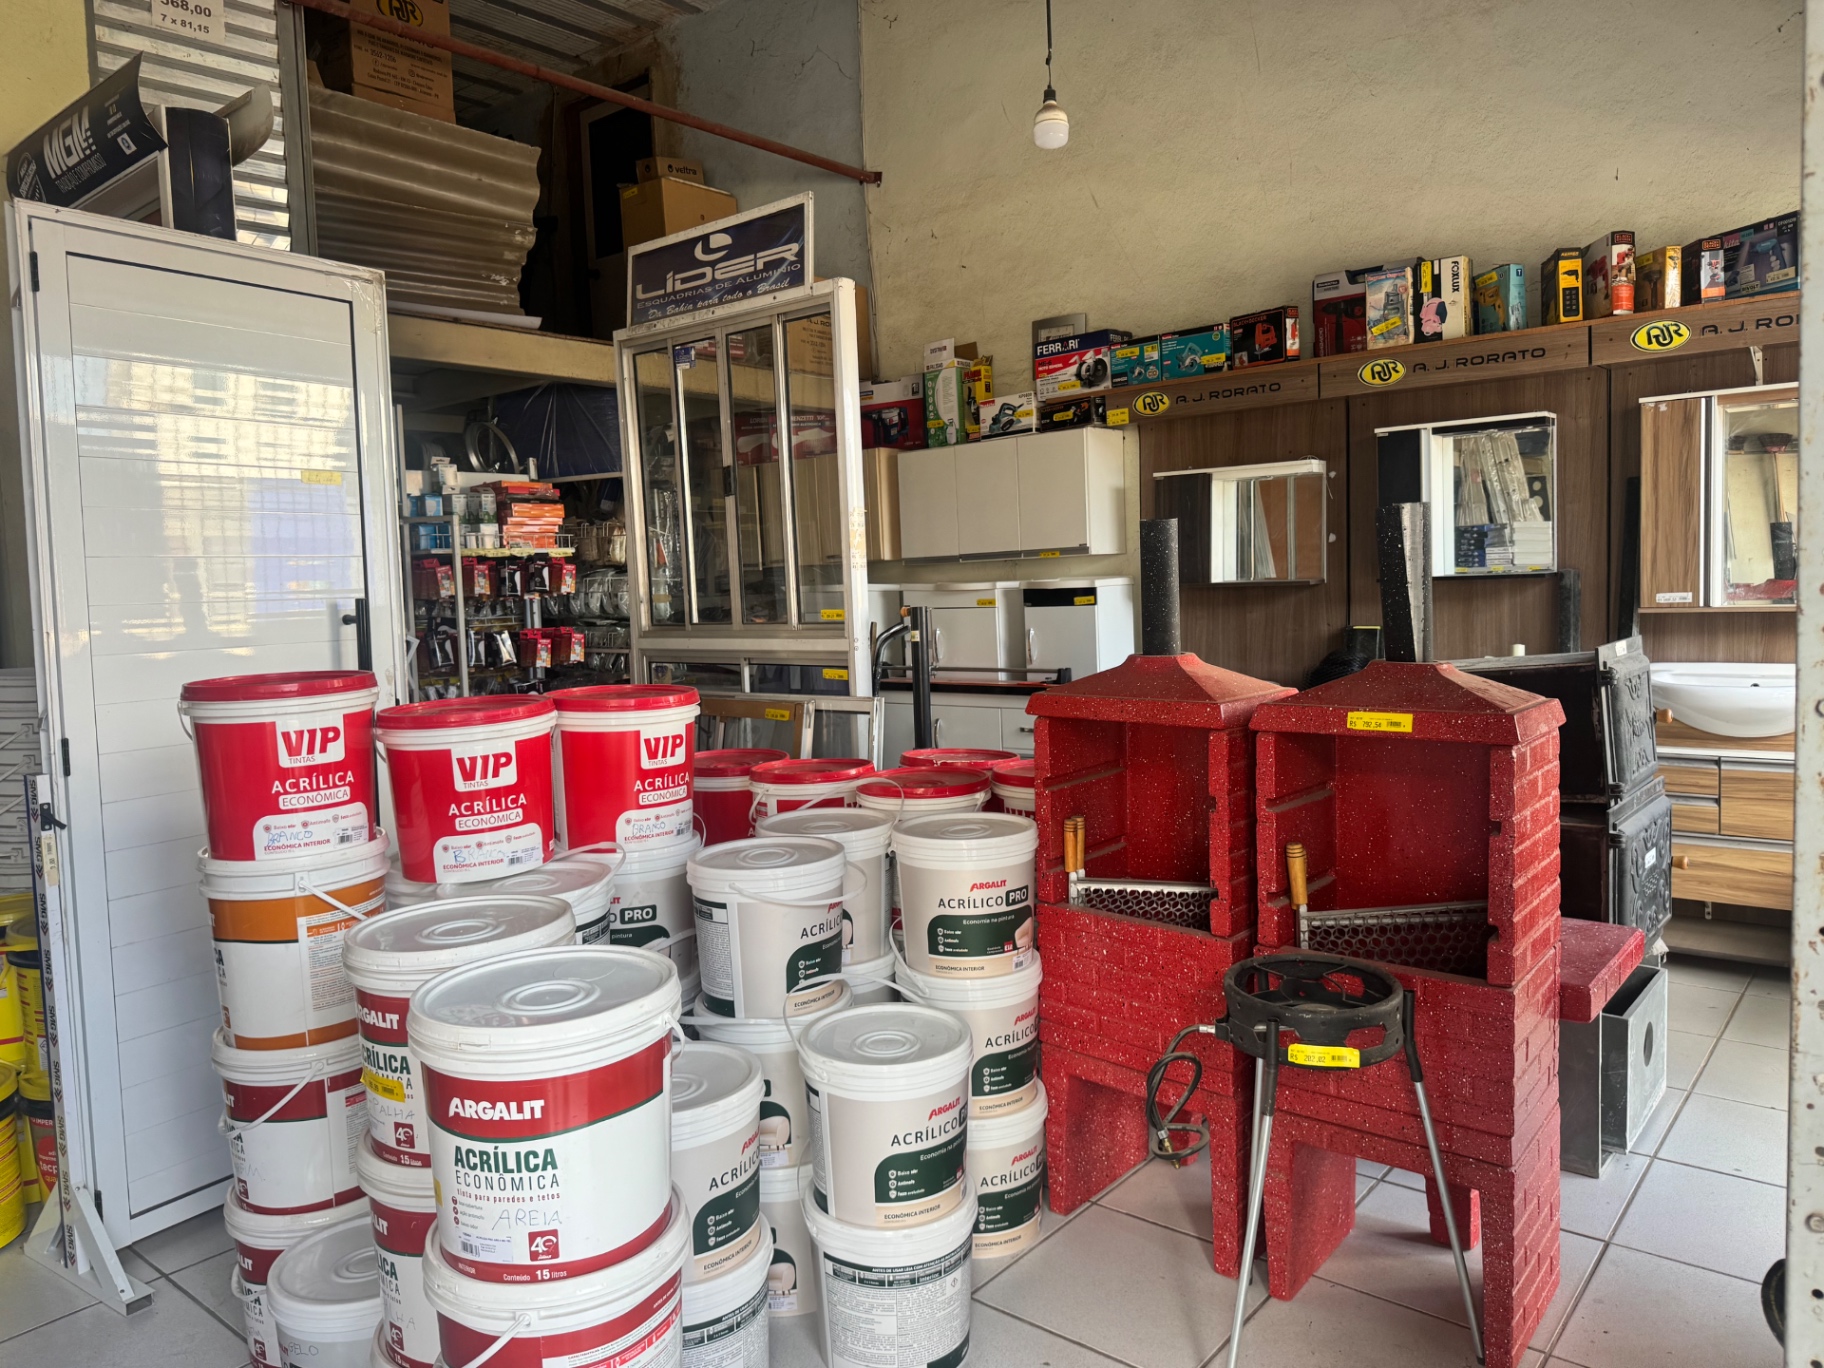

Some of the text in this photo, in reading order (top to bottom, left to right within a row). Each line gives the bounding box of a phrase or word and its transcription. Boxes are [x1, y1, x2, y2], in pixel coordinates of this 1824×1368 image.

[160, 13, 167, 21] 7
[180, 19, 210, 34] 81,15
[1451, 260, 1459, 293] FOXLUX
[636, 285, 712, 309] ESQUADRIAS
[715, 281, 733, 291] DE
[1036, 339, 1080, 356] FERRARI
[1456, 347, 1546, 368] RORATO
[1209, 382, 1281, 400] RORATO
[281, 726, 341, 758] VIP
[643, 733, 684, 760] VIP
[288, 755, 315, 764] TINTAS
[456, 752, 513, 782] VIP
[271, 770, 355, 794] ACRÍLICA
[463, 780, 489, 789] TINTAS
[633, 771, 690, 792] ACRÍLICA
[29, 779, 37, 806] SMG
[282, 788, 349, 807] ECONÔMICA
[641, 788, 687, 803] ECONÔMICA
[448, 793, 527, 816] ACRÍLICA
[458, 810, 521, 828] ECONÔMICA
[264, 838, 331, 851] ECONÔMICA INTERIOR
[267, 830, 313, 846] BRANCO
[33, 836, 42, 863] SMG
[443, 862, 477, 870] ECONÔMICA
[478, 858, 504, 867] INTERIOR
[969, 879, 1007, 893] ARGALIT
[38, 893, 47, 919] SMG
[938, 888, 1027, 909] ACRÍLICO PRO
[624, 908, 653, 921] PRO
[611, 932, 632, 940] pintura
[935, 964, 962, 972] ECONÔMICA
[49, 1005, 57, 1032] SMG
[985, 1022, 1034, 1049] ACRÍLICO
[362, 1044, 411, 1075] CRÍLICA
[53, 1060, 61, 1087] SMG
[448, 1097, 545, 1121] ARGALIT
[928, 1096, 961, 1121] ARGALIT
[979, 1102, 1006, 1112] ECONÔMICA
[57, 1115, 65, 1142] SMG
[890, 1117, 958, 1147] ACRÍLICO
[400, 1154, 409, 1164] 15
[454, 1145, 558, 1174] ACRÍLICA
[920, 1147, 947, 1161] Economia
[1011, 1145, 1038, 1167] ARGALIT
[62, 1170, 70, 1197] SMG
[455, 1170, 560, 1192] ECONÔMICA
[980, 1162, 1035, 1188] ACRÍLICO
[457, 1189, 472, 1199] tinta
[475, 1192, 490, 1202] para
[493, 1195, 525, 1204] paredes
[537, 1193, 560, 1201] tetos
[491, 1208, 562, 1231] AREIA
[884, 1204, 941, 1220] ECONÔMICA INTERIOR
[66, 1224, 75, 1250] SMG
[530, 1235, 557, 1253] 40
[974, 1240, 1003, 1248] ECONÔMICA
[703, 1240, 752, 1271] ECONÔMICA INTERIOR
[458, 1262, 476, 1275] INTERIOR
[503, 1269, 567, 1281] Conteúdo 15 litros
[288, 1341, 319, 1357] GELO
